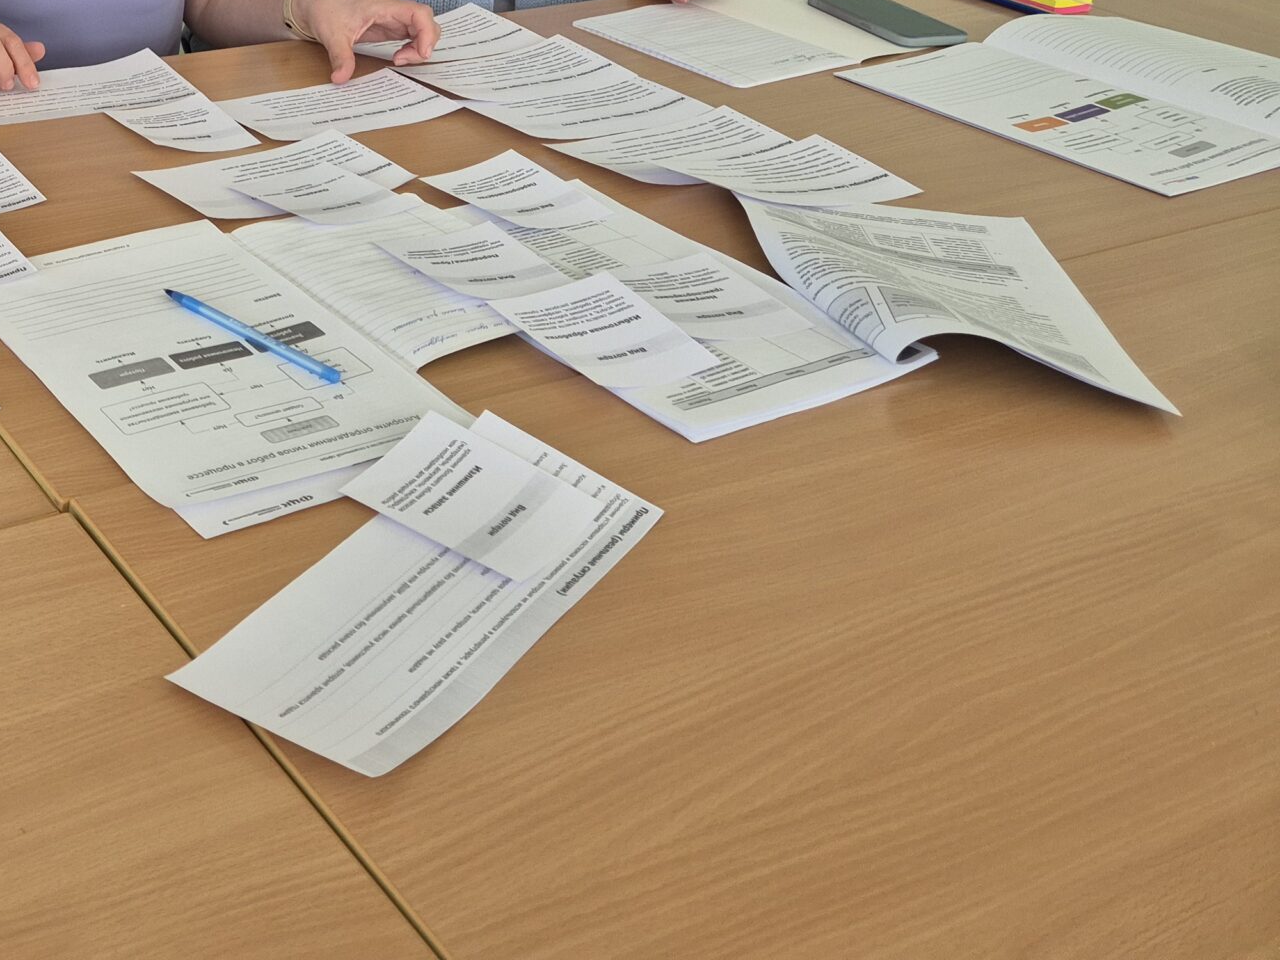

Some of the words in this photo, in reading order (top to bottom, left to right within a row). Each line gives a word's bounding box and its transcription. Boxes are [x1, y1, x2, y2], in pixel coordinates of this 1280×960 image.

[588, 314, 641, 334] Избыточная
[544, 330, 588, 340] обработка
[597, 351, 627, 361] потери
[627, 347, 647, 355] Вид
[212, 423, 227, 431] Нет
[374, 414, 420, 431] Алгоритм
[307, 426, 373, 449] определения
[276, 443, 307, 457] типов
[246, 452, 276, 466] работ
[186, 462, 236, 481] процессе
[233, 475, 259, 486] ФЦК
[446, 465, 482, 496] Излишние
[280, 494, 313, 509] ФЦК
[422, 495, 449, 516] запасы
[508, 504, 526, 517] Вид
[488, 516, 512, 537] потери
[618, 507, 649, 536] Примеры
[588, 535, 623, 566] (реальные
[556, 565, 591, 596] ситуации)
